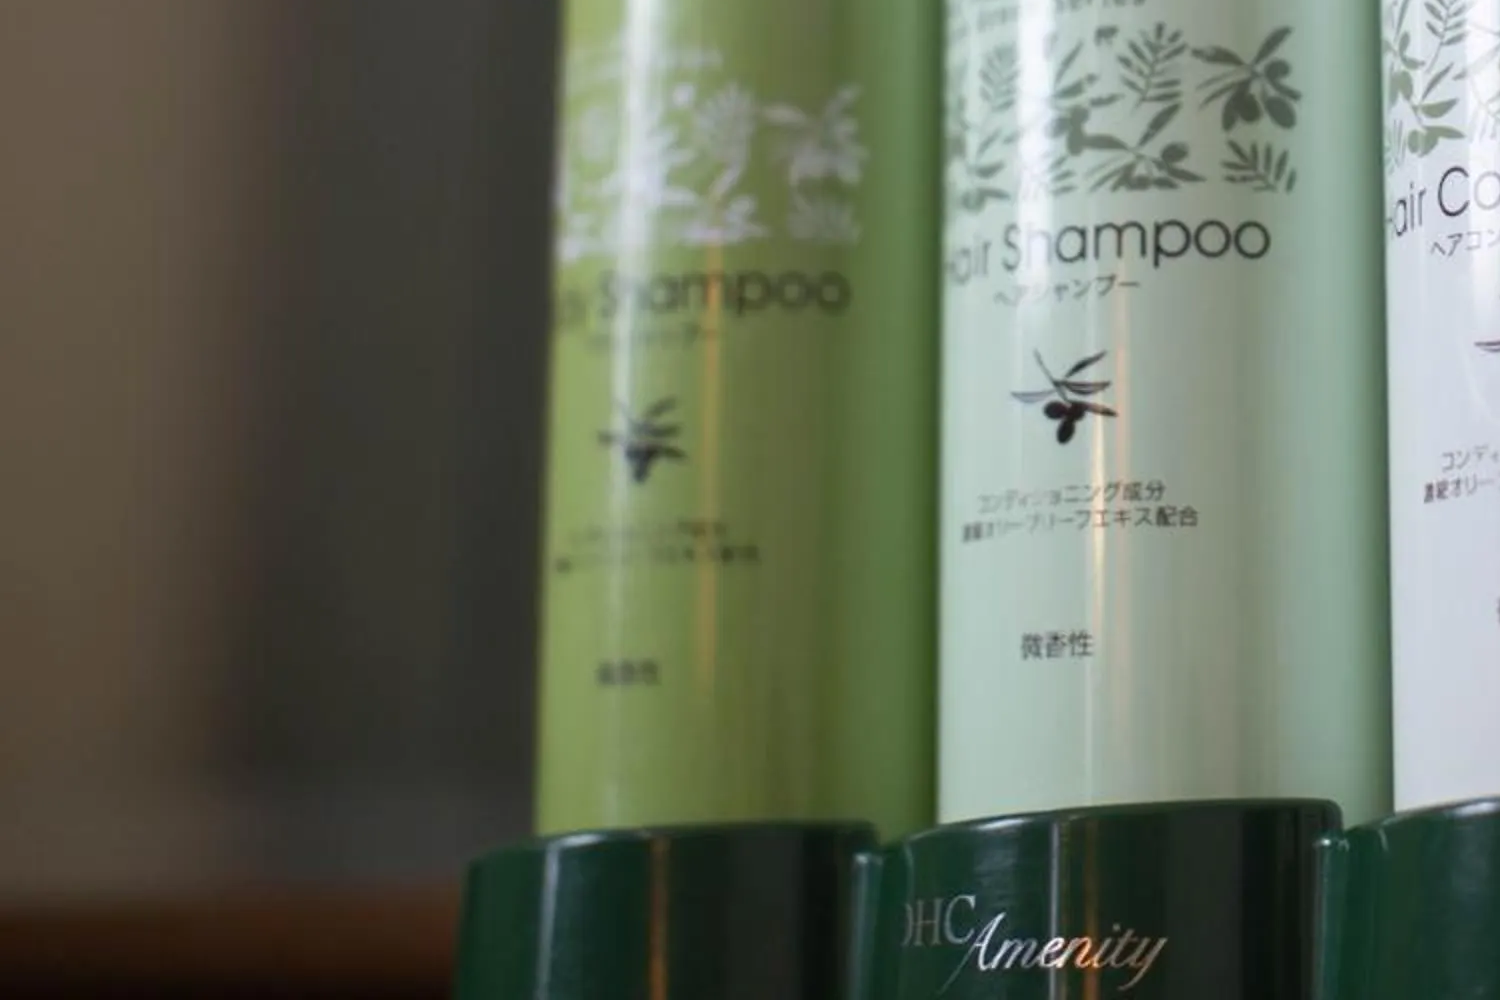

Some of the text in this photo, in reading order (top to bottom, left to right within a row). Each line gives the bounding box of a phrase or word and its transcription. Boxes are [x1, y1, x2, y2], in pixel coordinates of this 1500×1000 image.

[947, 218, 1272, 286] air Shampoo
[597, 268, 852, 317] Sampoo
[940, 910, 1170, 995] Amenity
